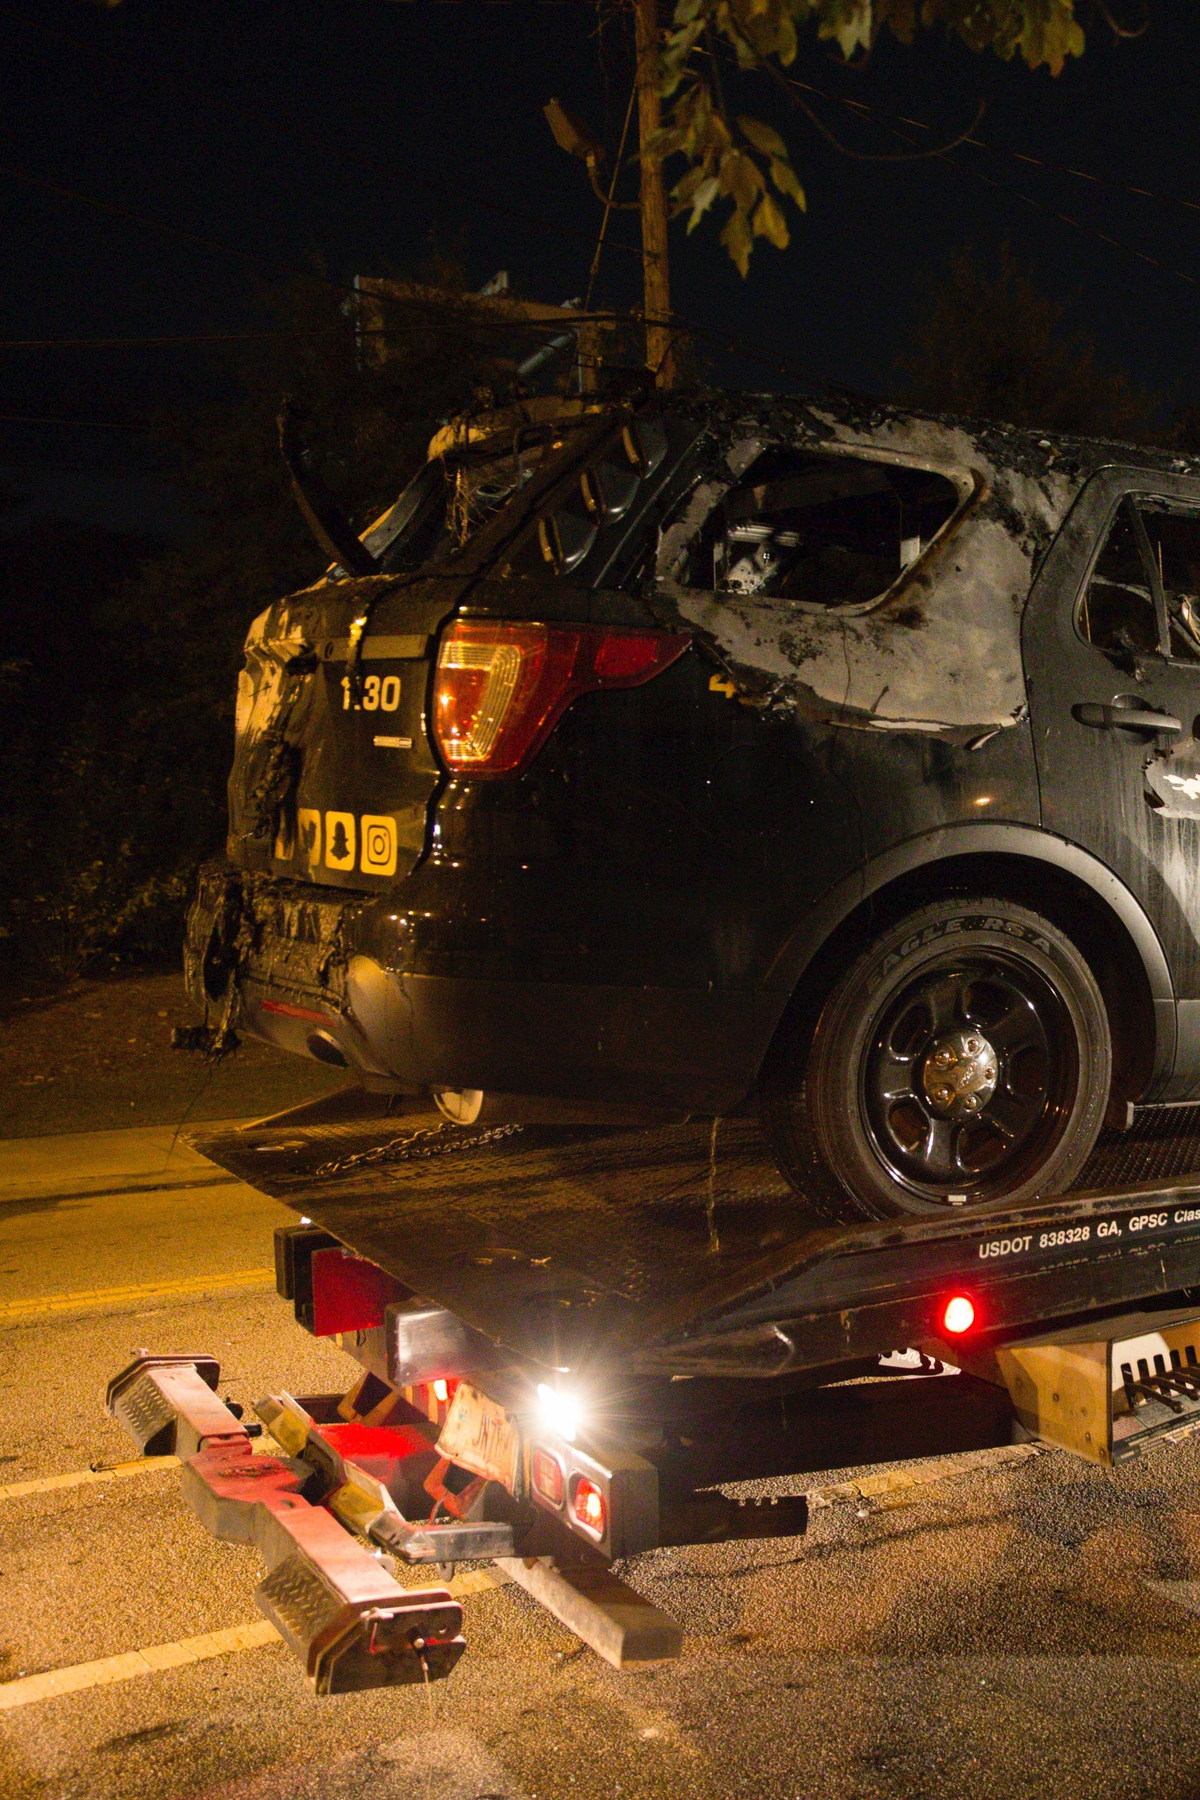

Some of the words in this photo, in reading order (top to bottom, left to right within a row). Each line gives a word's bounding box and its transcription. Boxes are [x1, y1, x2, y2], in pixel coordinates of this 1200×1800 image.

[341, 676, 401, 712] 130
[979, 1235, 1033, 1259] USDOT
[1039, 1226, 1091, 1248] 838328
[1096, 1220, 1123, 1238] GA,
[1128, 1212, 1169, 1232] GPSC
